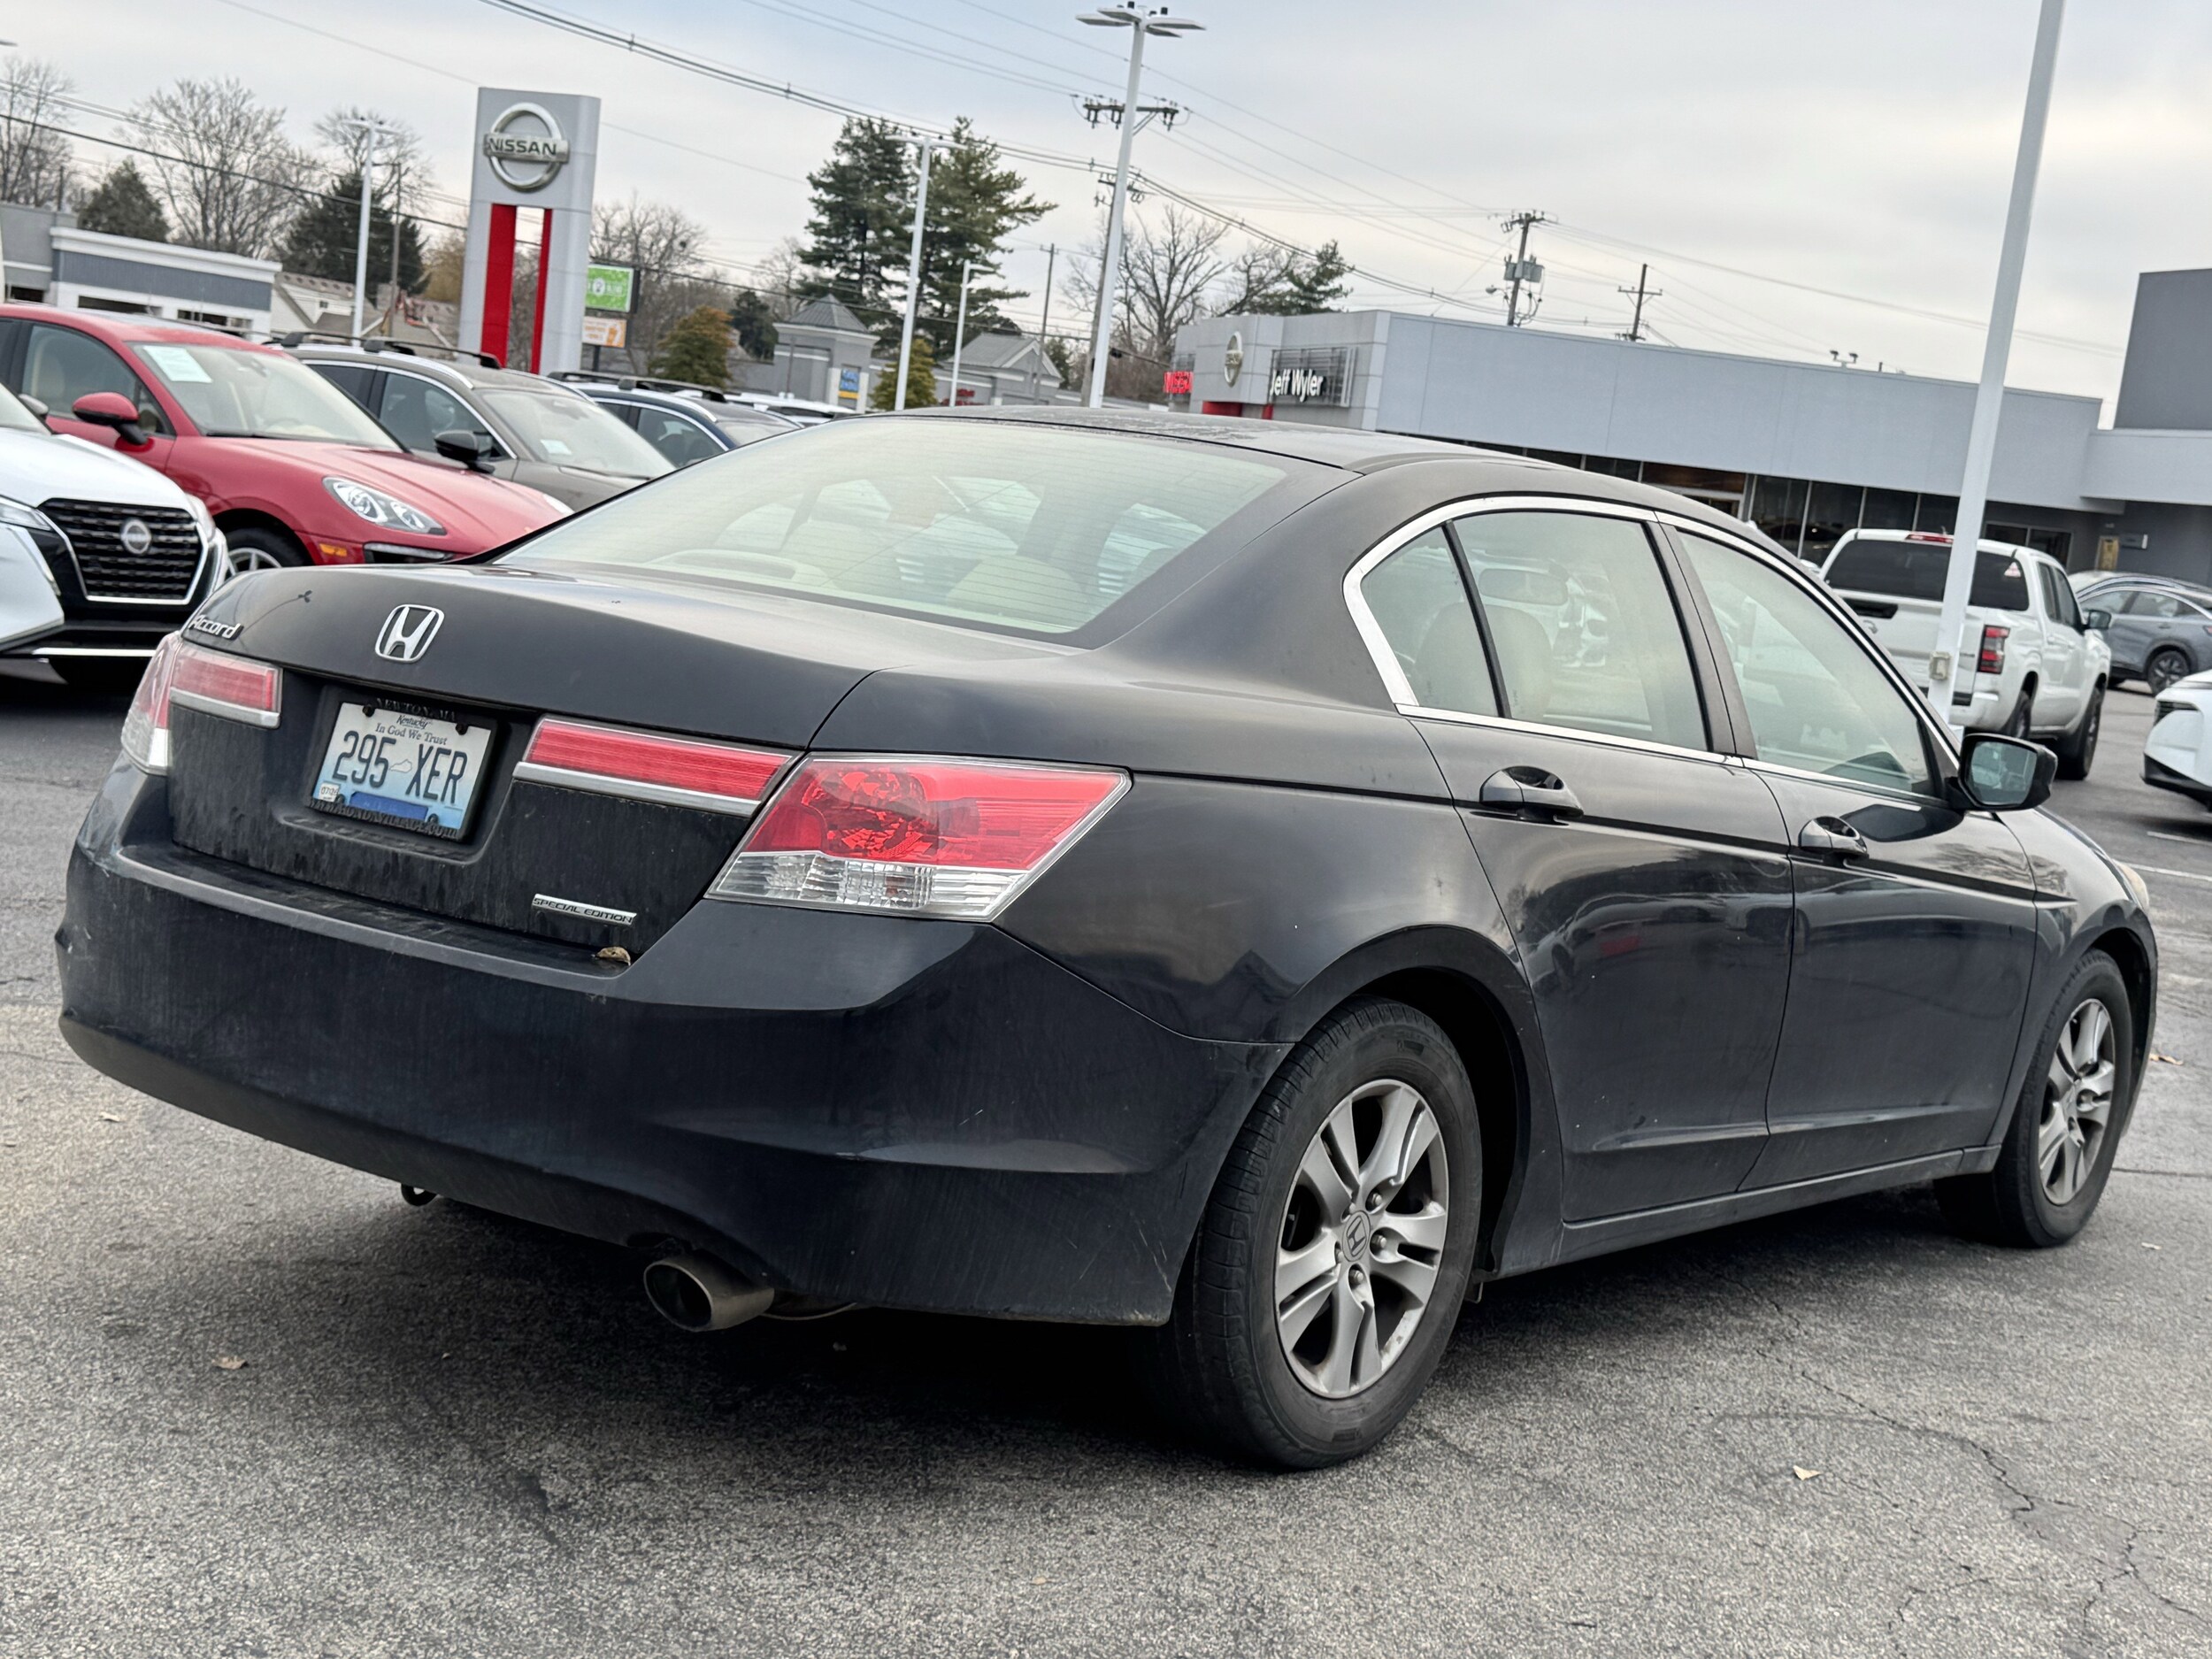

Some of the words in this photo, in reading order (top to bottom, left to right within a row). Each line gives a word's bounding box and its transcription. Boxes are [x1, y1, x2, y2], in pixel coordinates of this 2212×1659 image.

[489, 138, 557, 156] NISSAN
[1270, 368, 1291, 396] Jeff
[1292, 368, 1324, 403] Wyler
[188, 614, 241, 639] Accord
[375, 722, 386, 733] In
[388, 725, 406, 738] God
[409, 729, 422, 741] We
[425, 732, 448, 745] Trust
[396, 714, 428, 730] Kentucky
[332, 730, 396, 788] 295
[405, 743, 468, 804] XER
[534, 897, 580, 914] SPECIAL
[584, 908, 633, 923] EDITION
